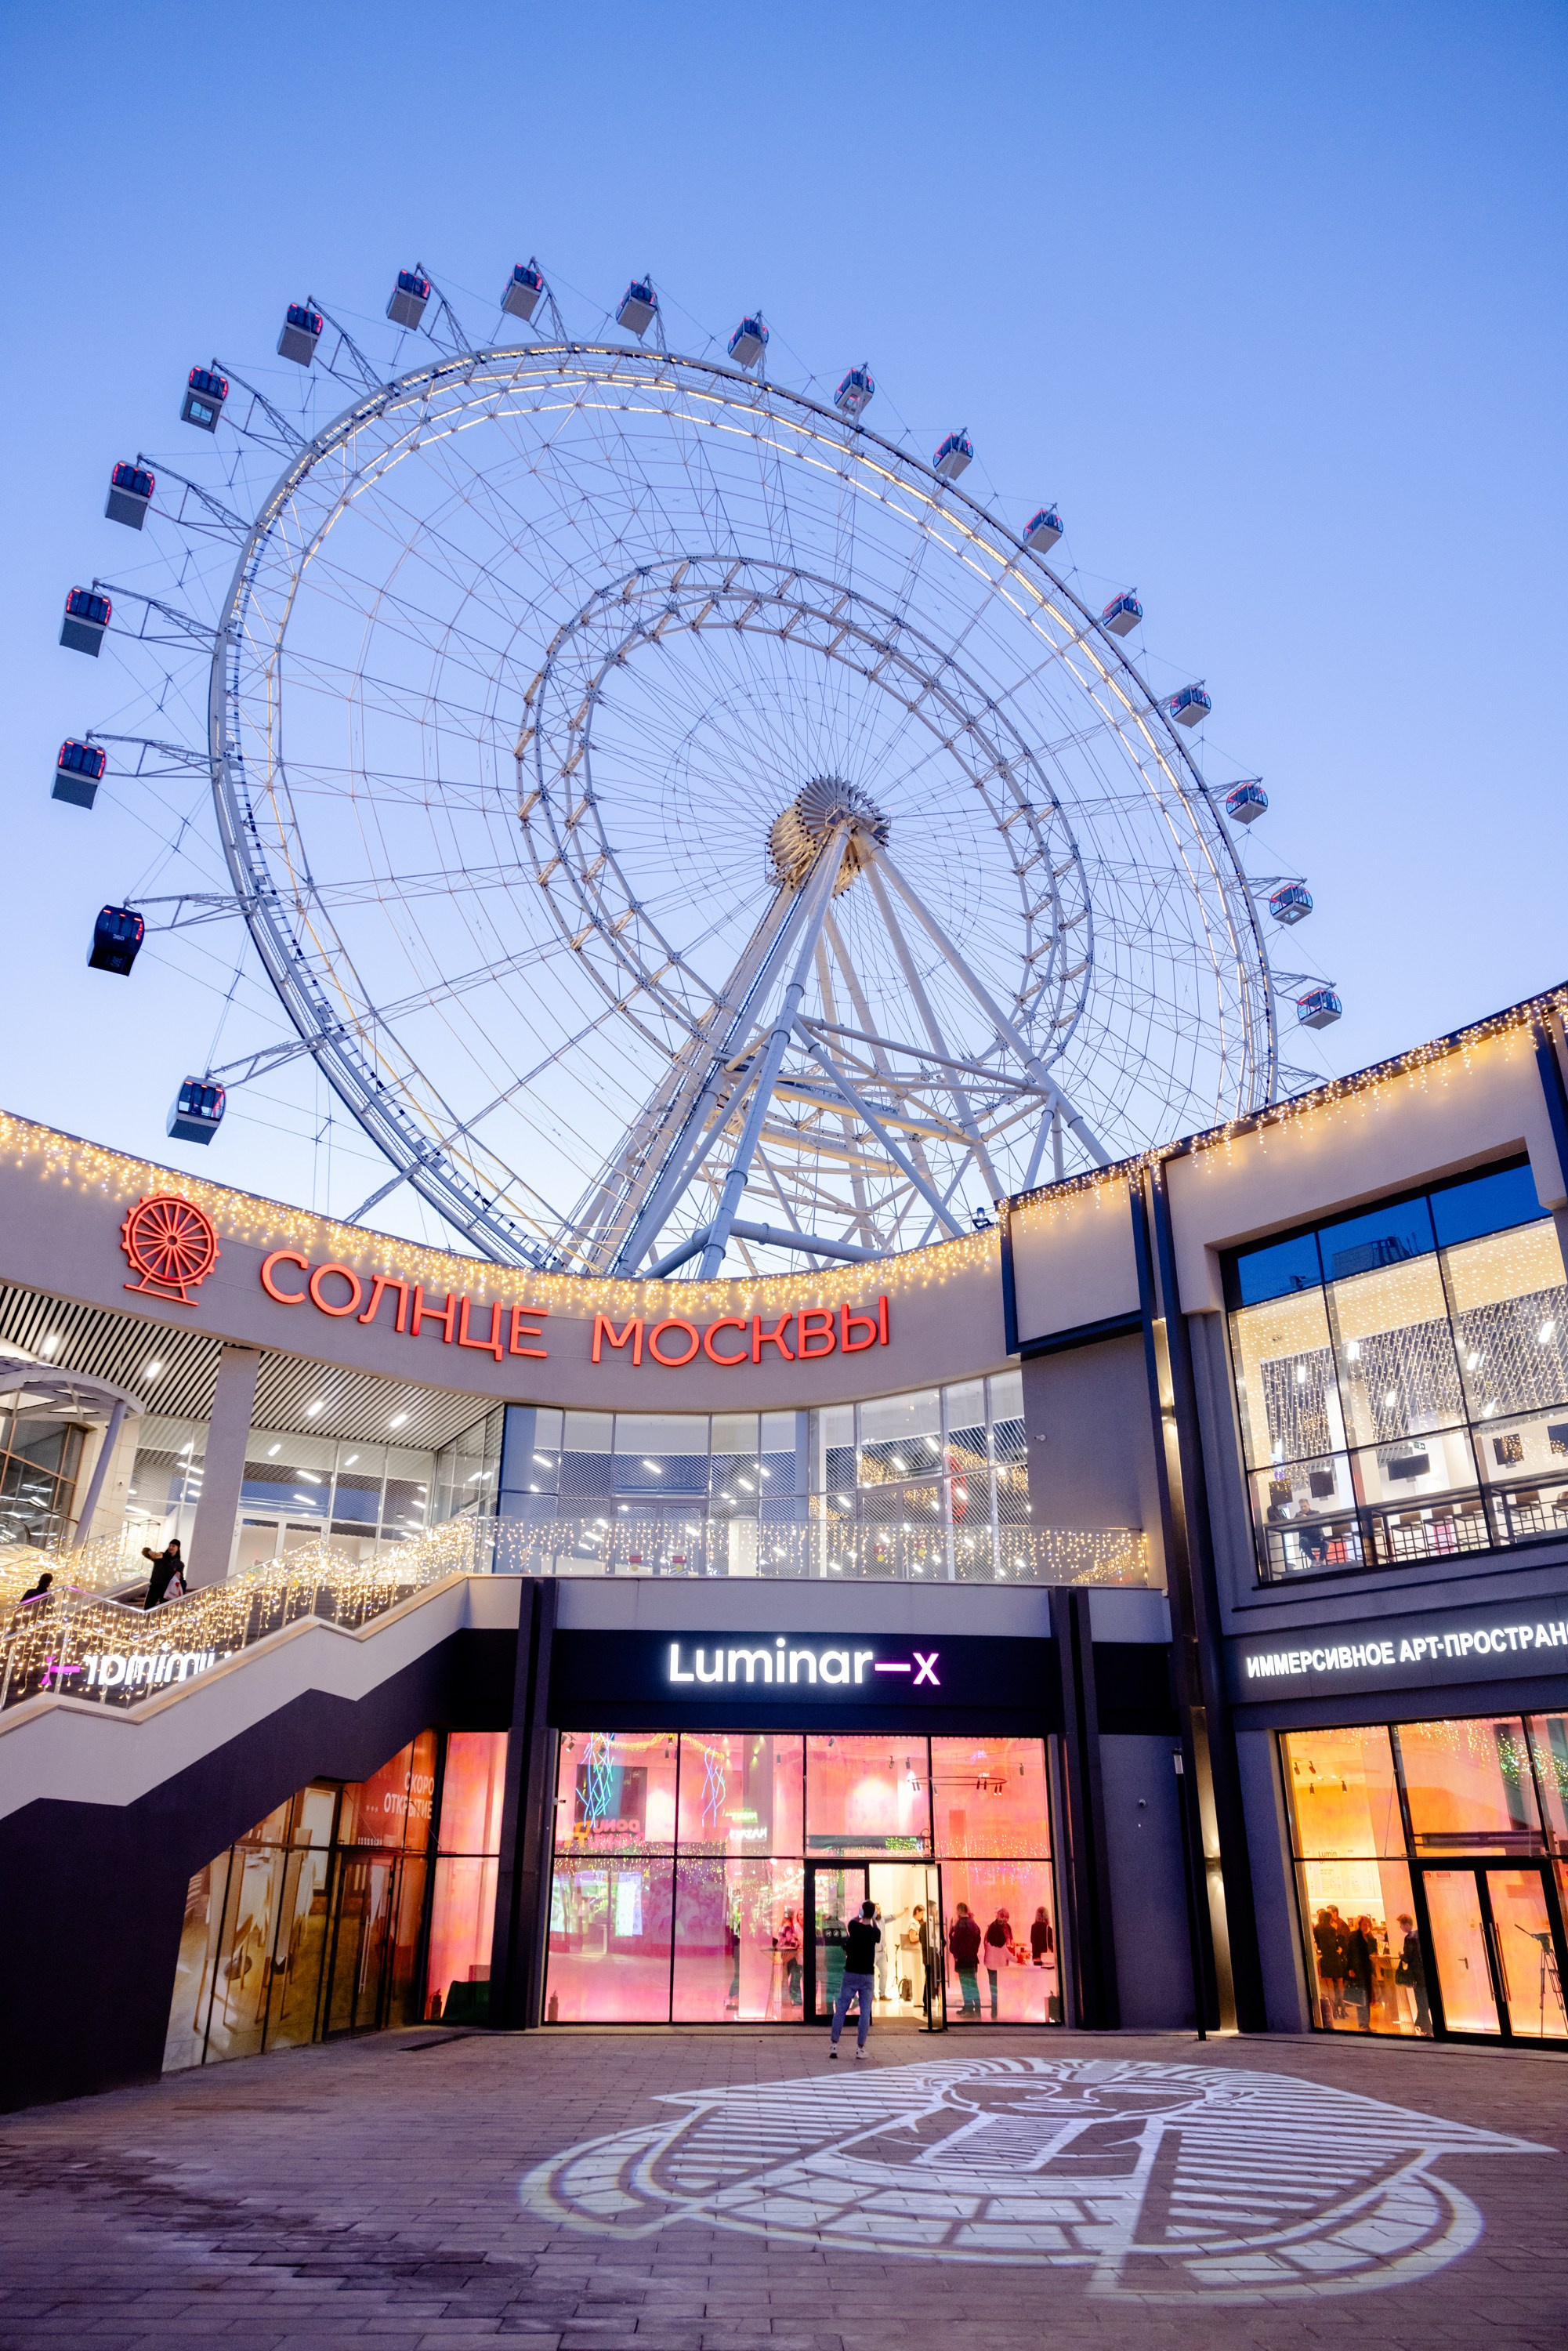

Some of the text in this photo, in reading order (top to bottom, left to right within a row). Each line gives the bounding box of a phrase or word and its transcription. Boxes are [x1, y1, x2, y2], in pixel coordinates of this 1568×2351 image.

[260, 1248, 889, 1367] СОЛНЦЕ МОСКВЫ
[1246, 1621, 1568, 1679] ИММЕРСИВНОЕ АРТ-ПРОСТРАН
[404, 1771, 435, 1796] СКОРО
[383, 1792, 433, 1820] ОТКРЫТИЕ
